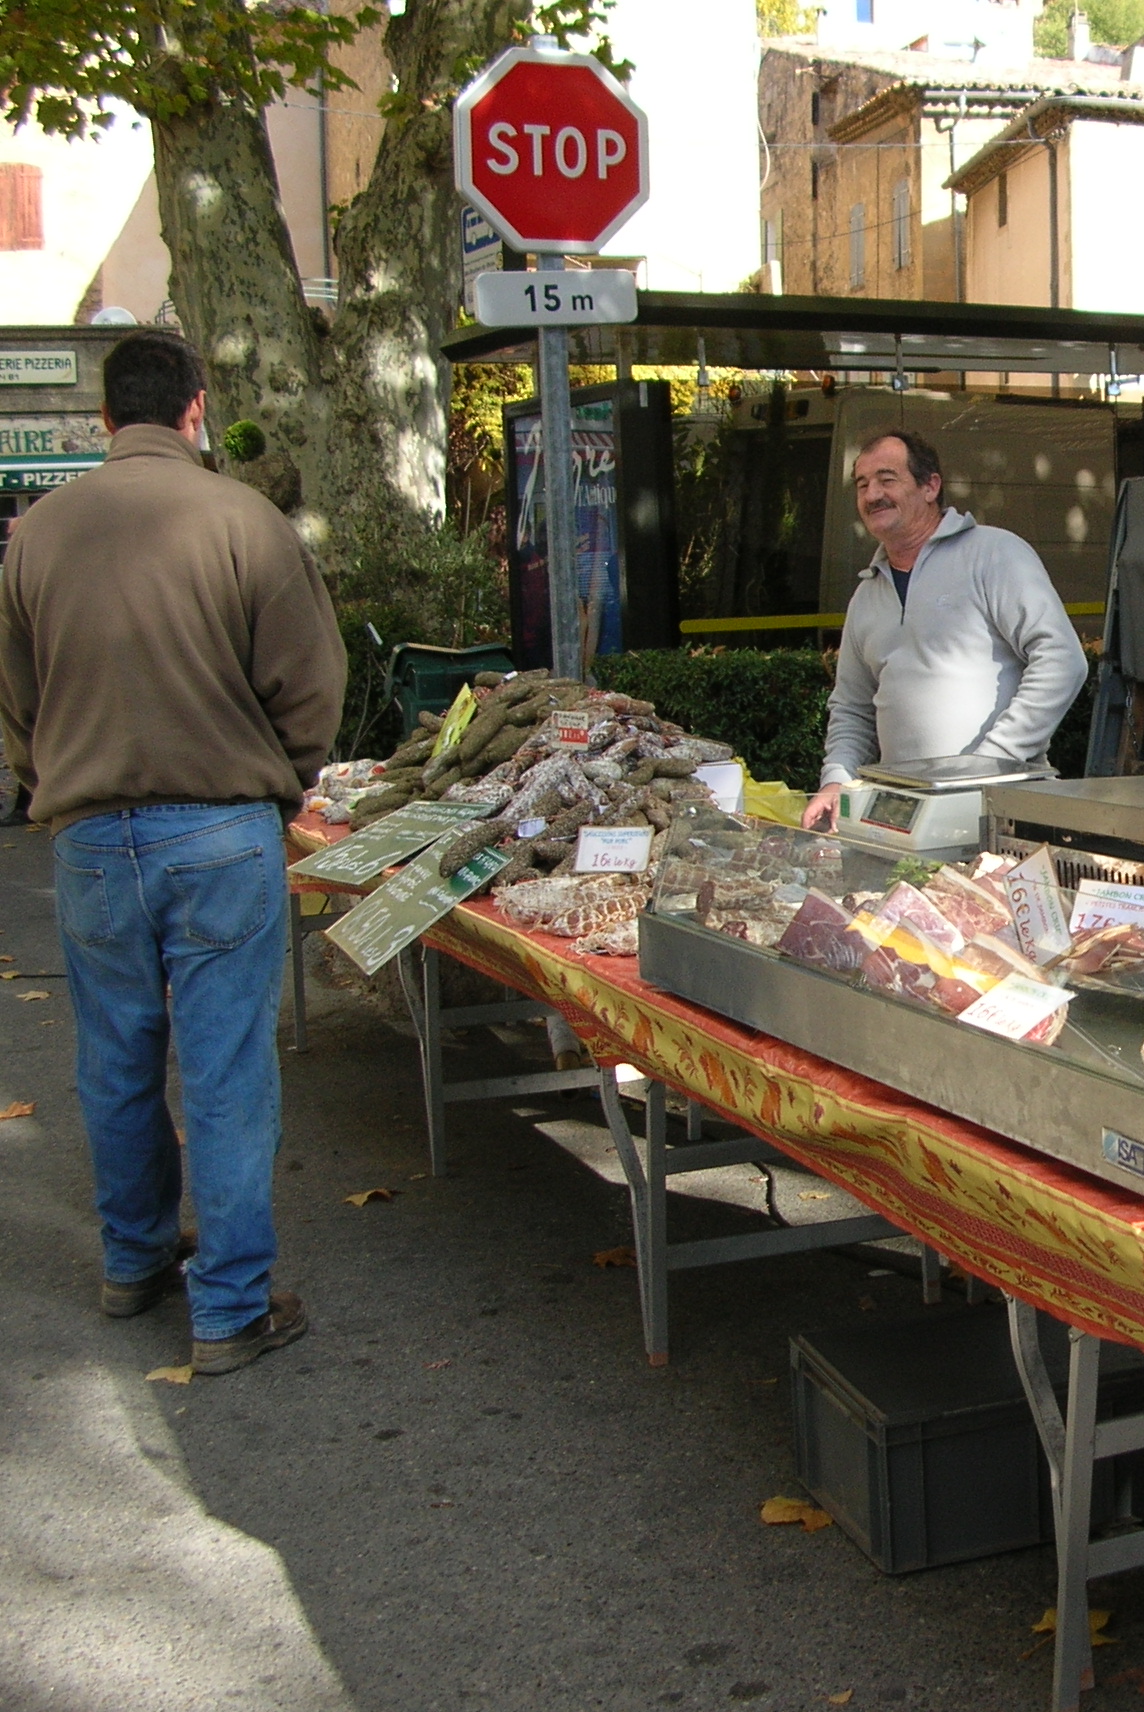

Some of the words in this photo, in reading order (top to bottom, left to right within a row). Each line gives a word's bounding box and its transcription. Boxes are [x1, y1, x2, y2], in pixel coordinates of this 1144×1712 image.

[486, 121, 627, 180] STOP
[524, 284, 562, 313] 15
[571, 292, 594, 312] m
[25, 358, 72, 370] PIZZERIA
[23, 471, 86, 487] PIZZE
